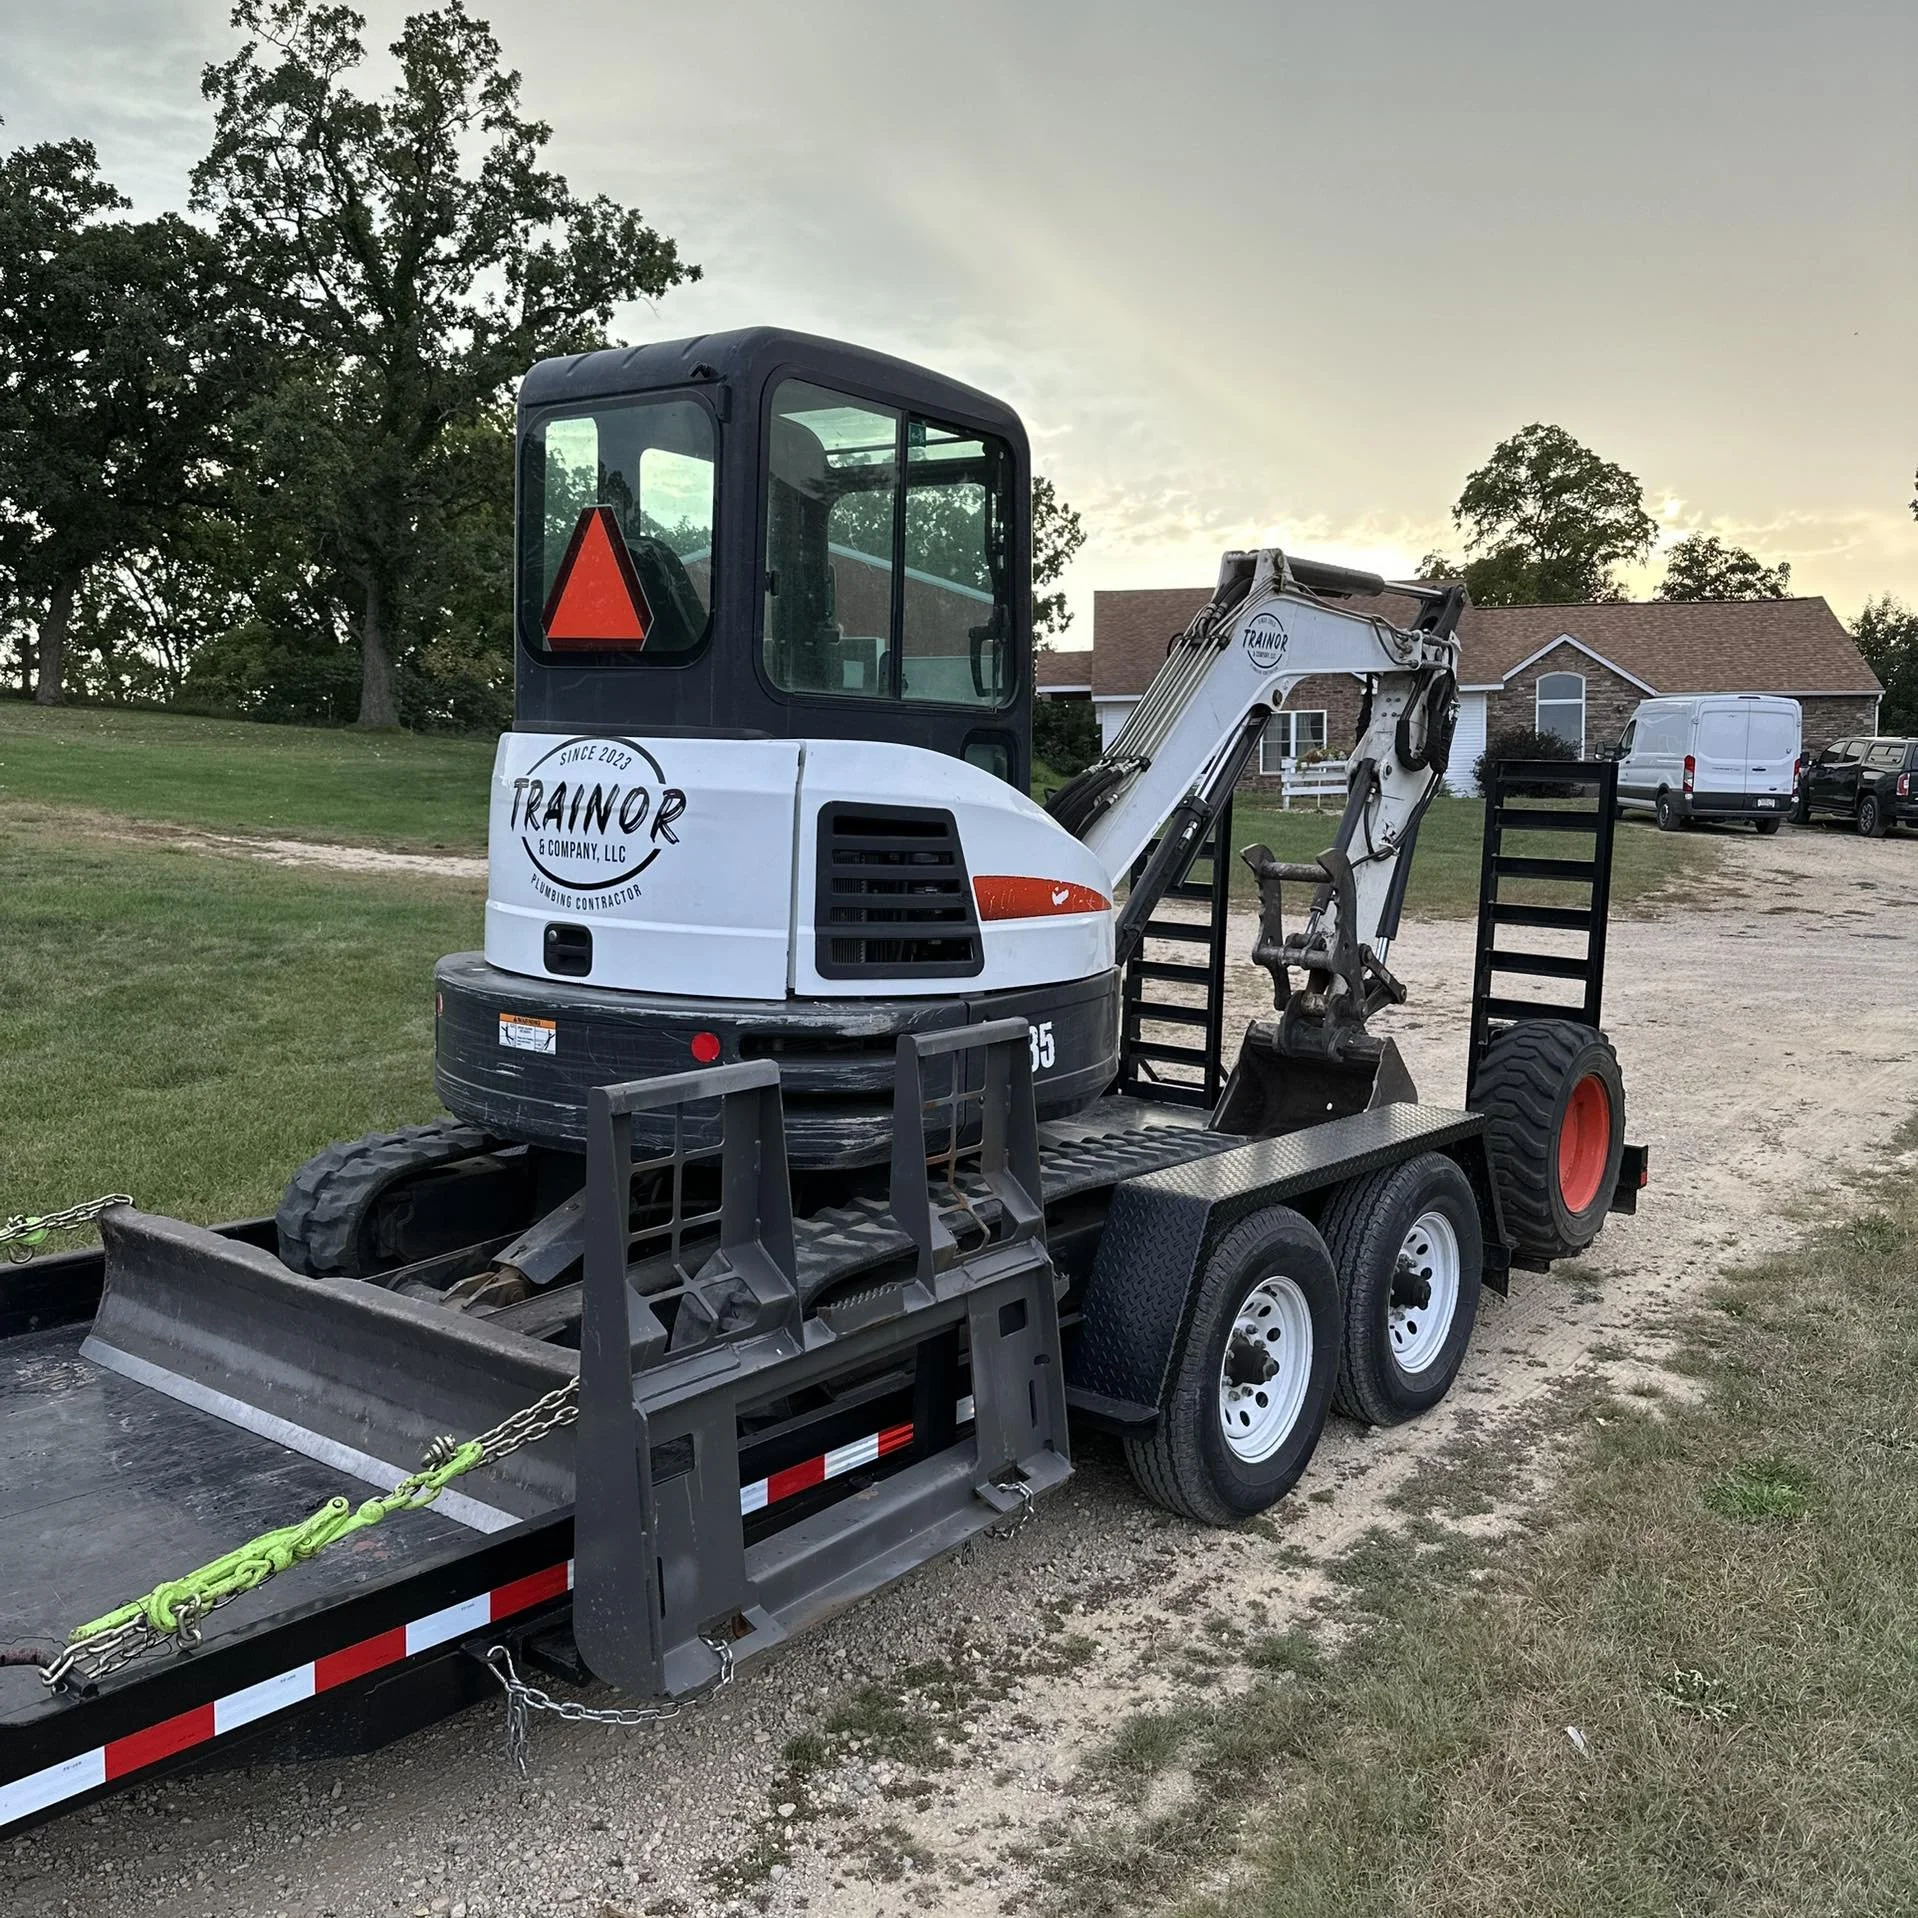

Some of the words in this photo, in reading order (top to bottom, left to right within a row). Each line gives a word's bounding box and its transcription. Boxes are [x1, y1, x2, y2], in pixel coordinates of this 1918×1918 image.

[1242, 629, 1289, 652] TRAINOR
[560, 745, 597, 766] SINCE
[598, 746, 632, 770] 2023
[511, 777, 687, 844] TRAINOR
[539, 838, 545, 856] &
[548, 839, 600, 864] COMPANY,
[604, 844, 626, 863] LLC
[530, 873, 572, 908] PLUMBING
[575, 884, 642, 911] CONTRACTOR
